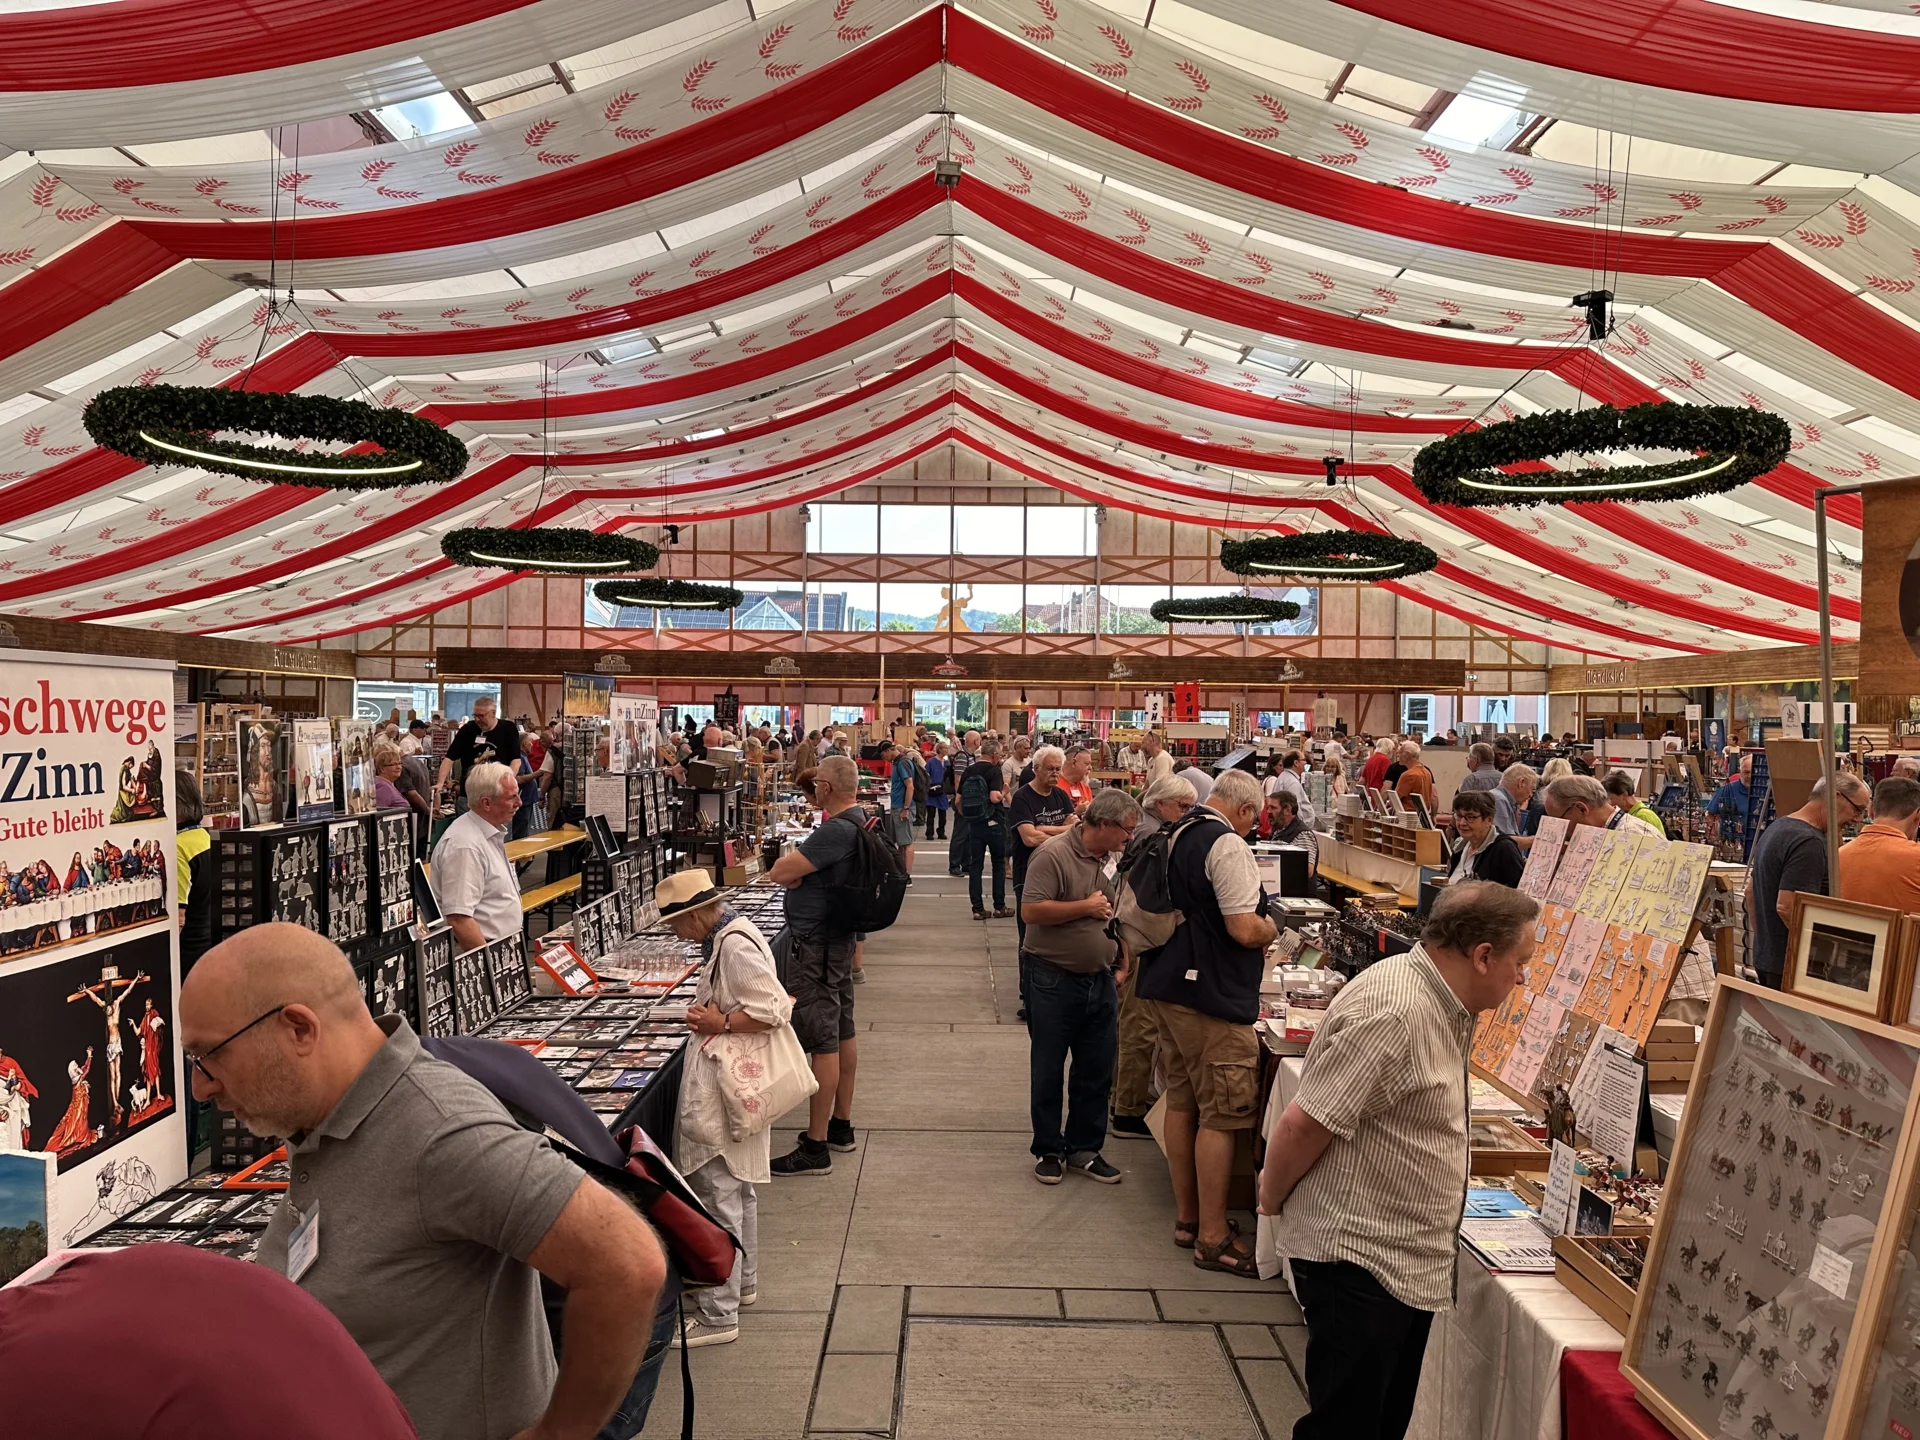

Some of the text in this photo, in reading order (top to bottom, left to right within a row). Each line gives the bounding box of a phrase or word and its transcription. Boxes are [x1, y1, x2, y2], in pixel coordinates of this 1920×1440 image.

[0, 748, 105, 803] Zinn
[52, 807, 105, 834] bleibt
[1892, 1423, 1910, 1438] NEU
